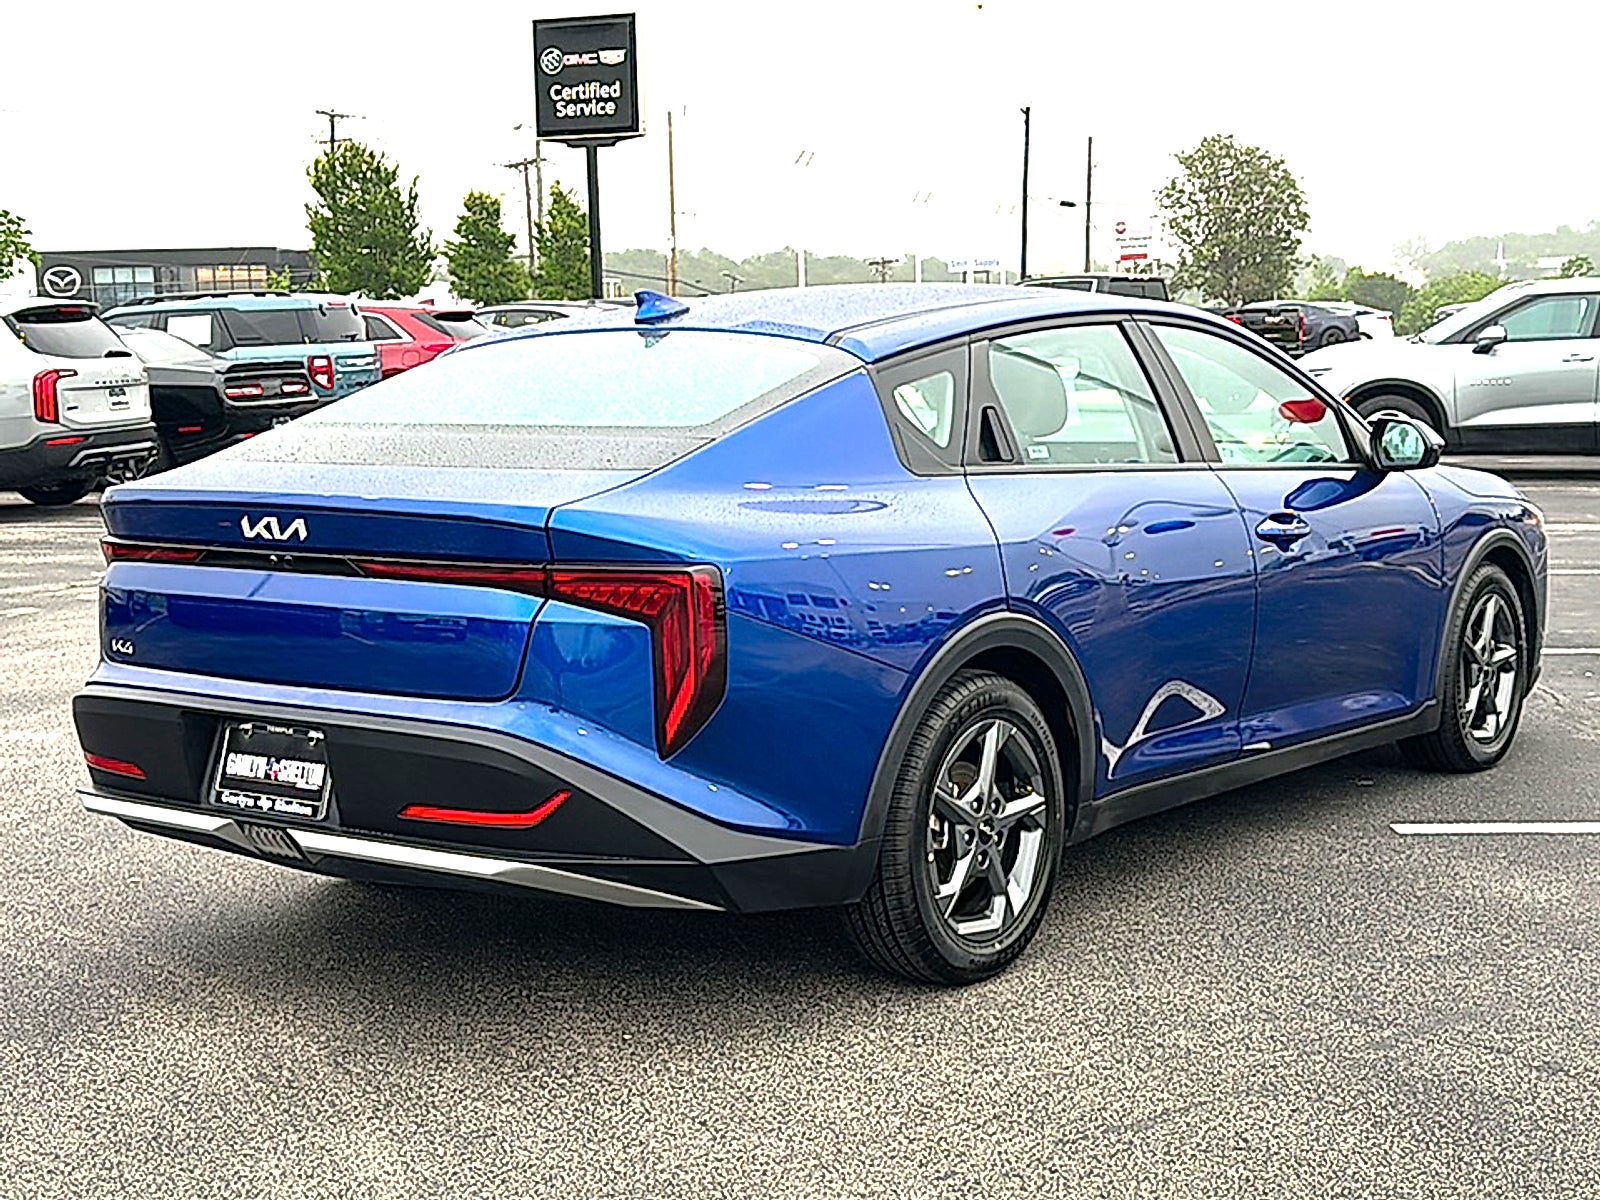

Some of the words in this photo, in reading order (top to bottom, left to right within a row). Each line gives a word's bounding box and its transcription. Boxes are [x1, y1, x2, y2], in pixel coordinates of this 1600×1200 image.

[562, 53, 599, 66] GMC
[549, 80, 621, 101] Certified
[555, 99, 617, 118] Service
[240, 515, 308, 541] KIA
[111, 638, 134, 655] K4
